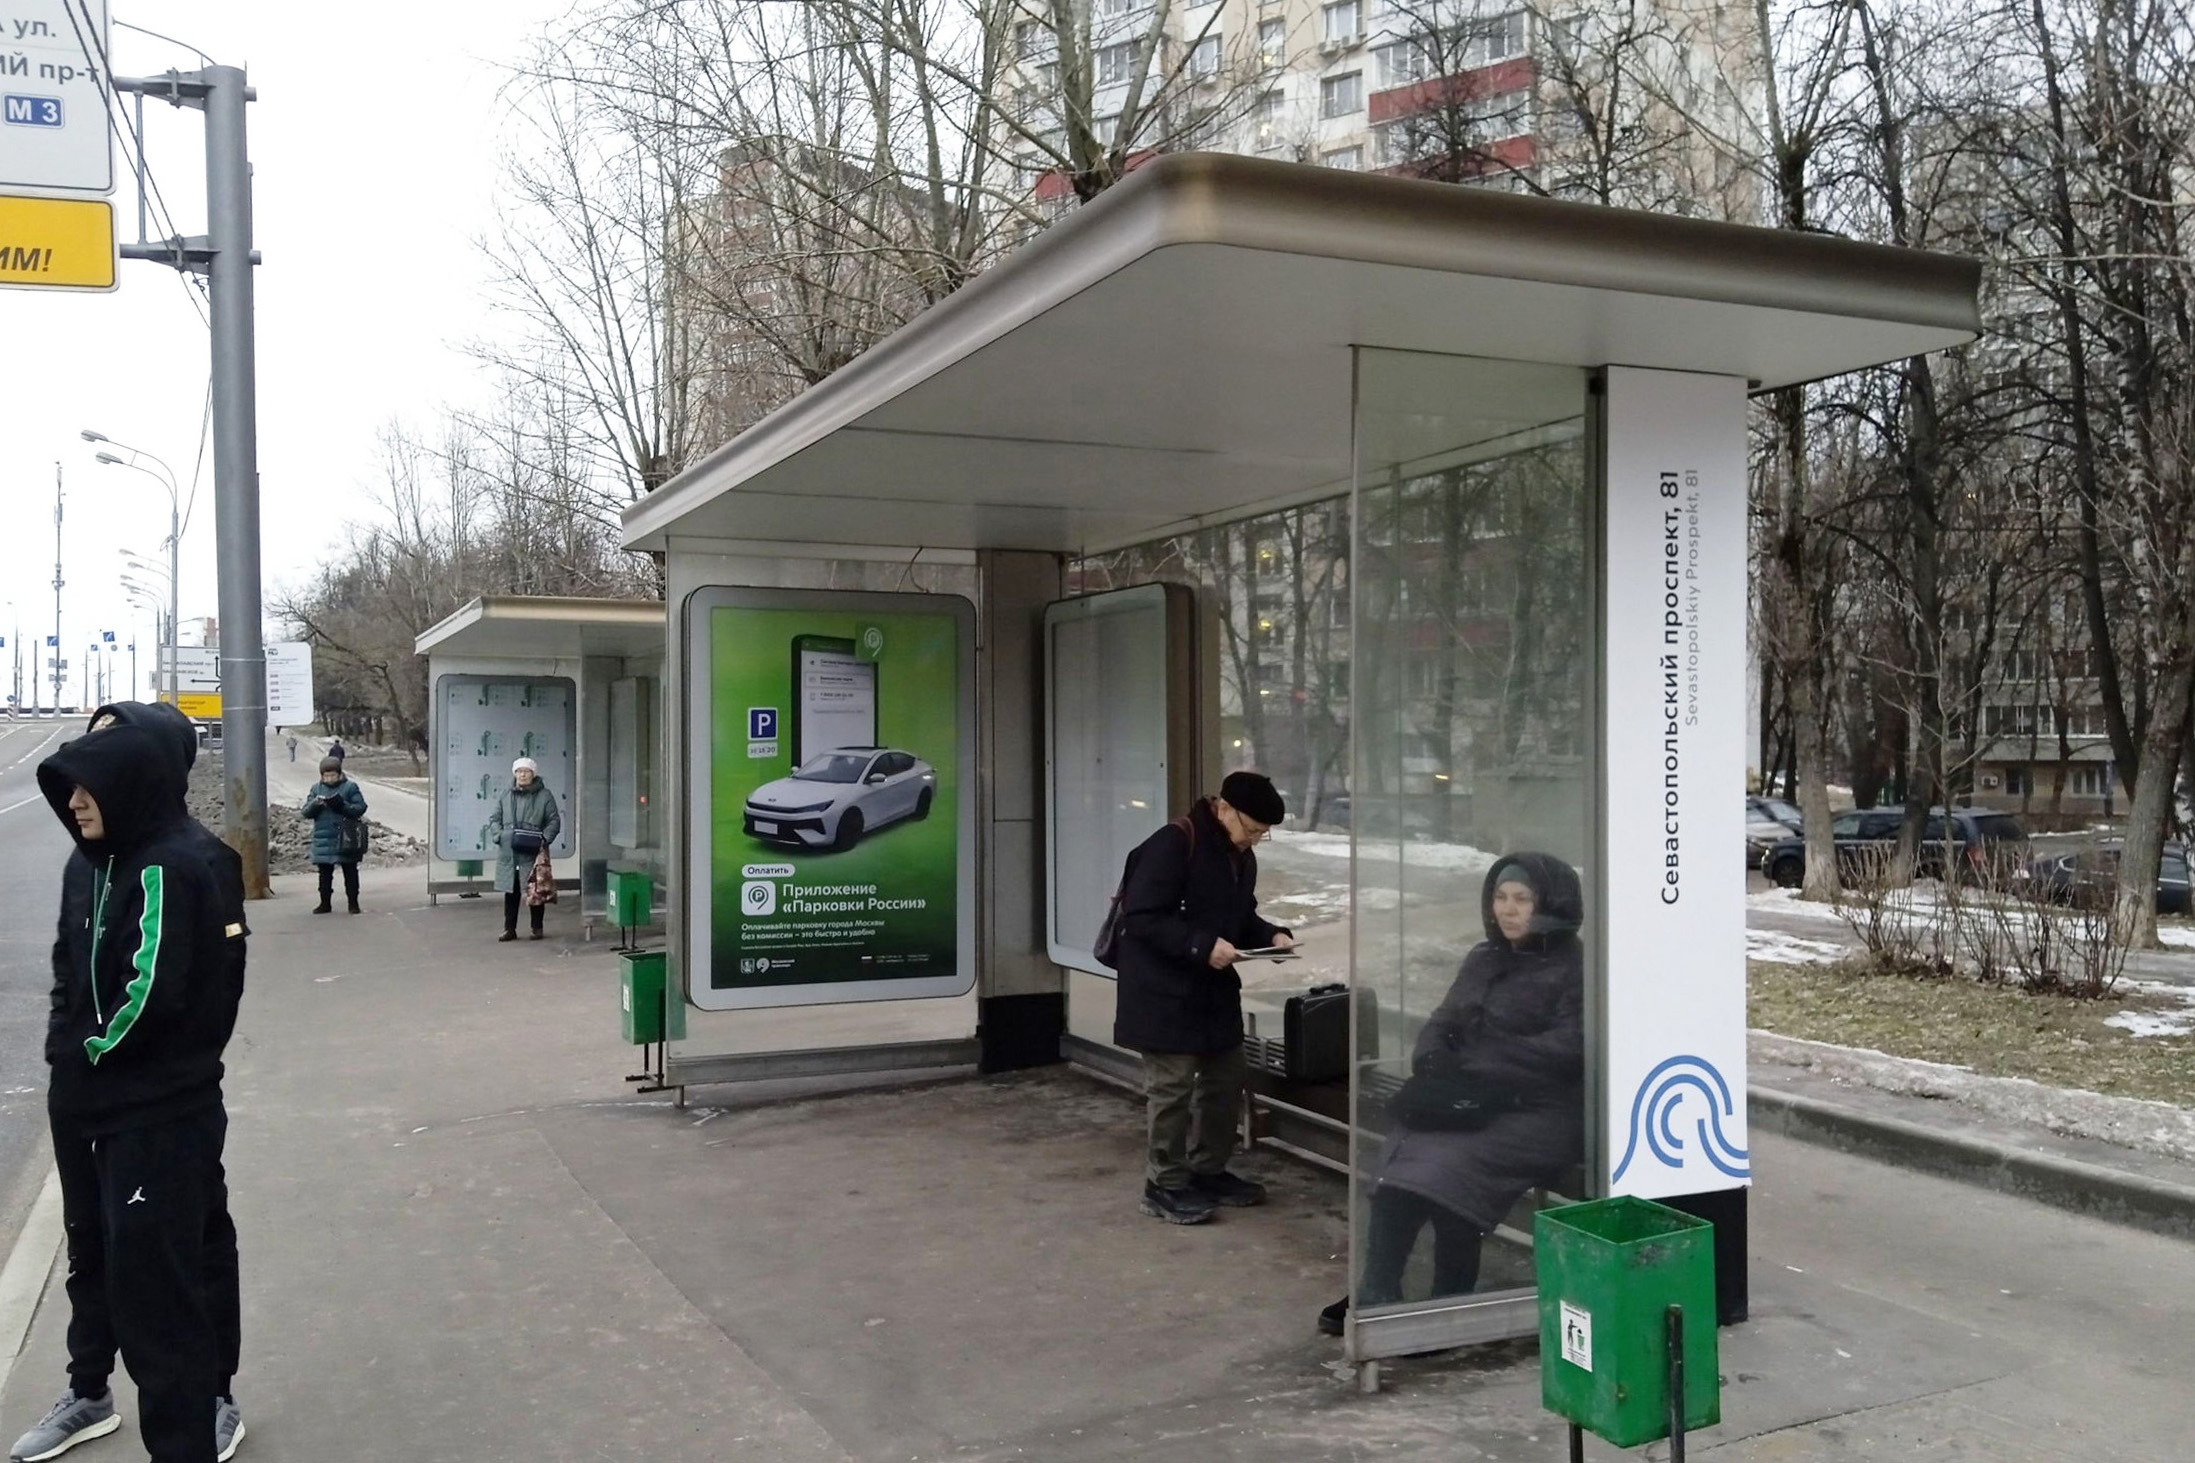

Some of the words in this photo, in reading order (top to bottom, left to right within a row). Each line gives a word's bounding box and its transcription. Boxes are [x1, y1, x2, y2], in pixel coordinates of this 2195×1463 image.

[13, 18, 57, 40] ул.
[40, 63, 100, 85] пр-т
[1659, 471, 1679, 499] 81
[1684, 469, 1699, 488] 81
[1684, 492, 1701, 580] Prospekt,
[1664, 506, 1683, 645] проспект,
[1684, 585, 1701, 726] Sevastopolskiy
[757, 713, 772, 736] P
[1660, 655, 1680, 905] Севастопольский
[747, 866, 790, 876] Оплатить
[783, 883, 878, 899] Приложение
[782, 899, 865, 915] «Парковки
[867, 897, 927, 911] России»
[741, 922, 791, 932] Оплачивайте
[792, 922, 827, 931] парковку
[828, 921, 854, 929] города
[854, 919, 886, 928] Москвы
[741, 932, 756, 940] без
[814, 930, 842, 938] быстро
[848, 928, 876, 937] удобно
